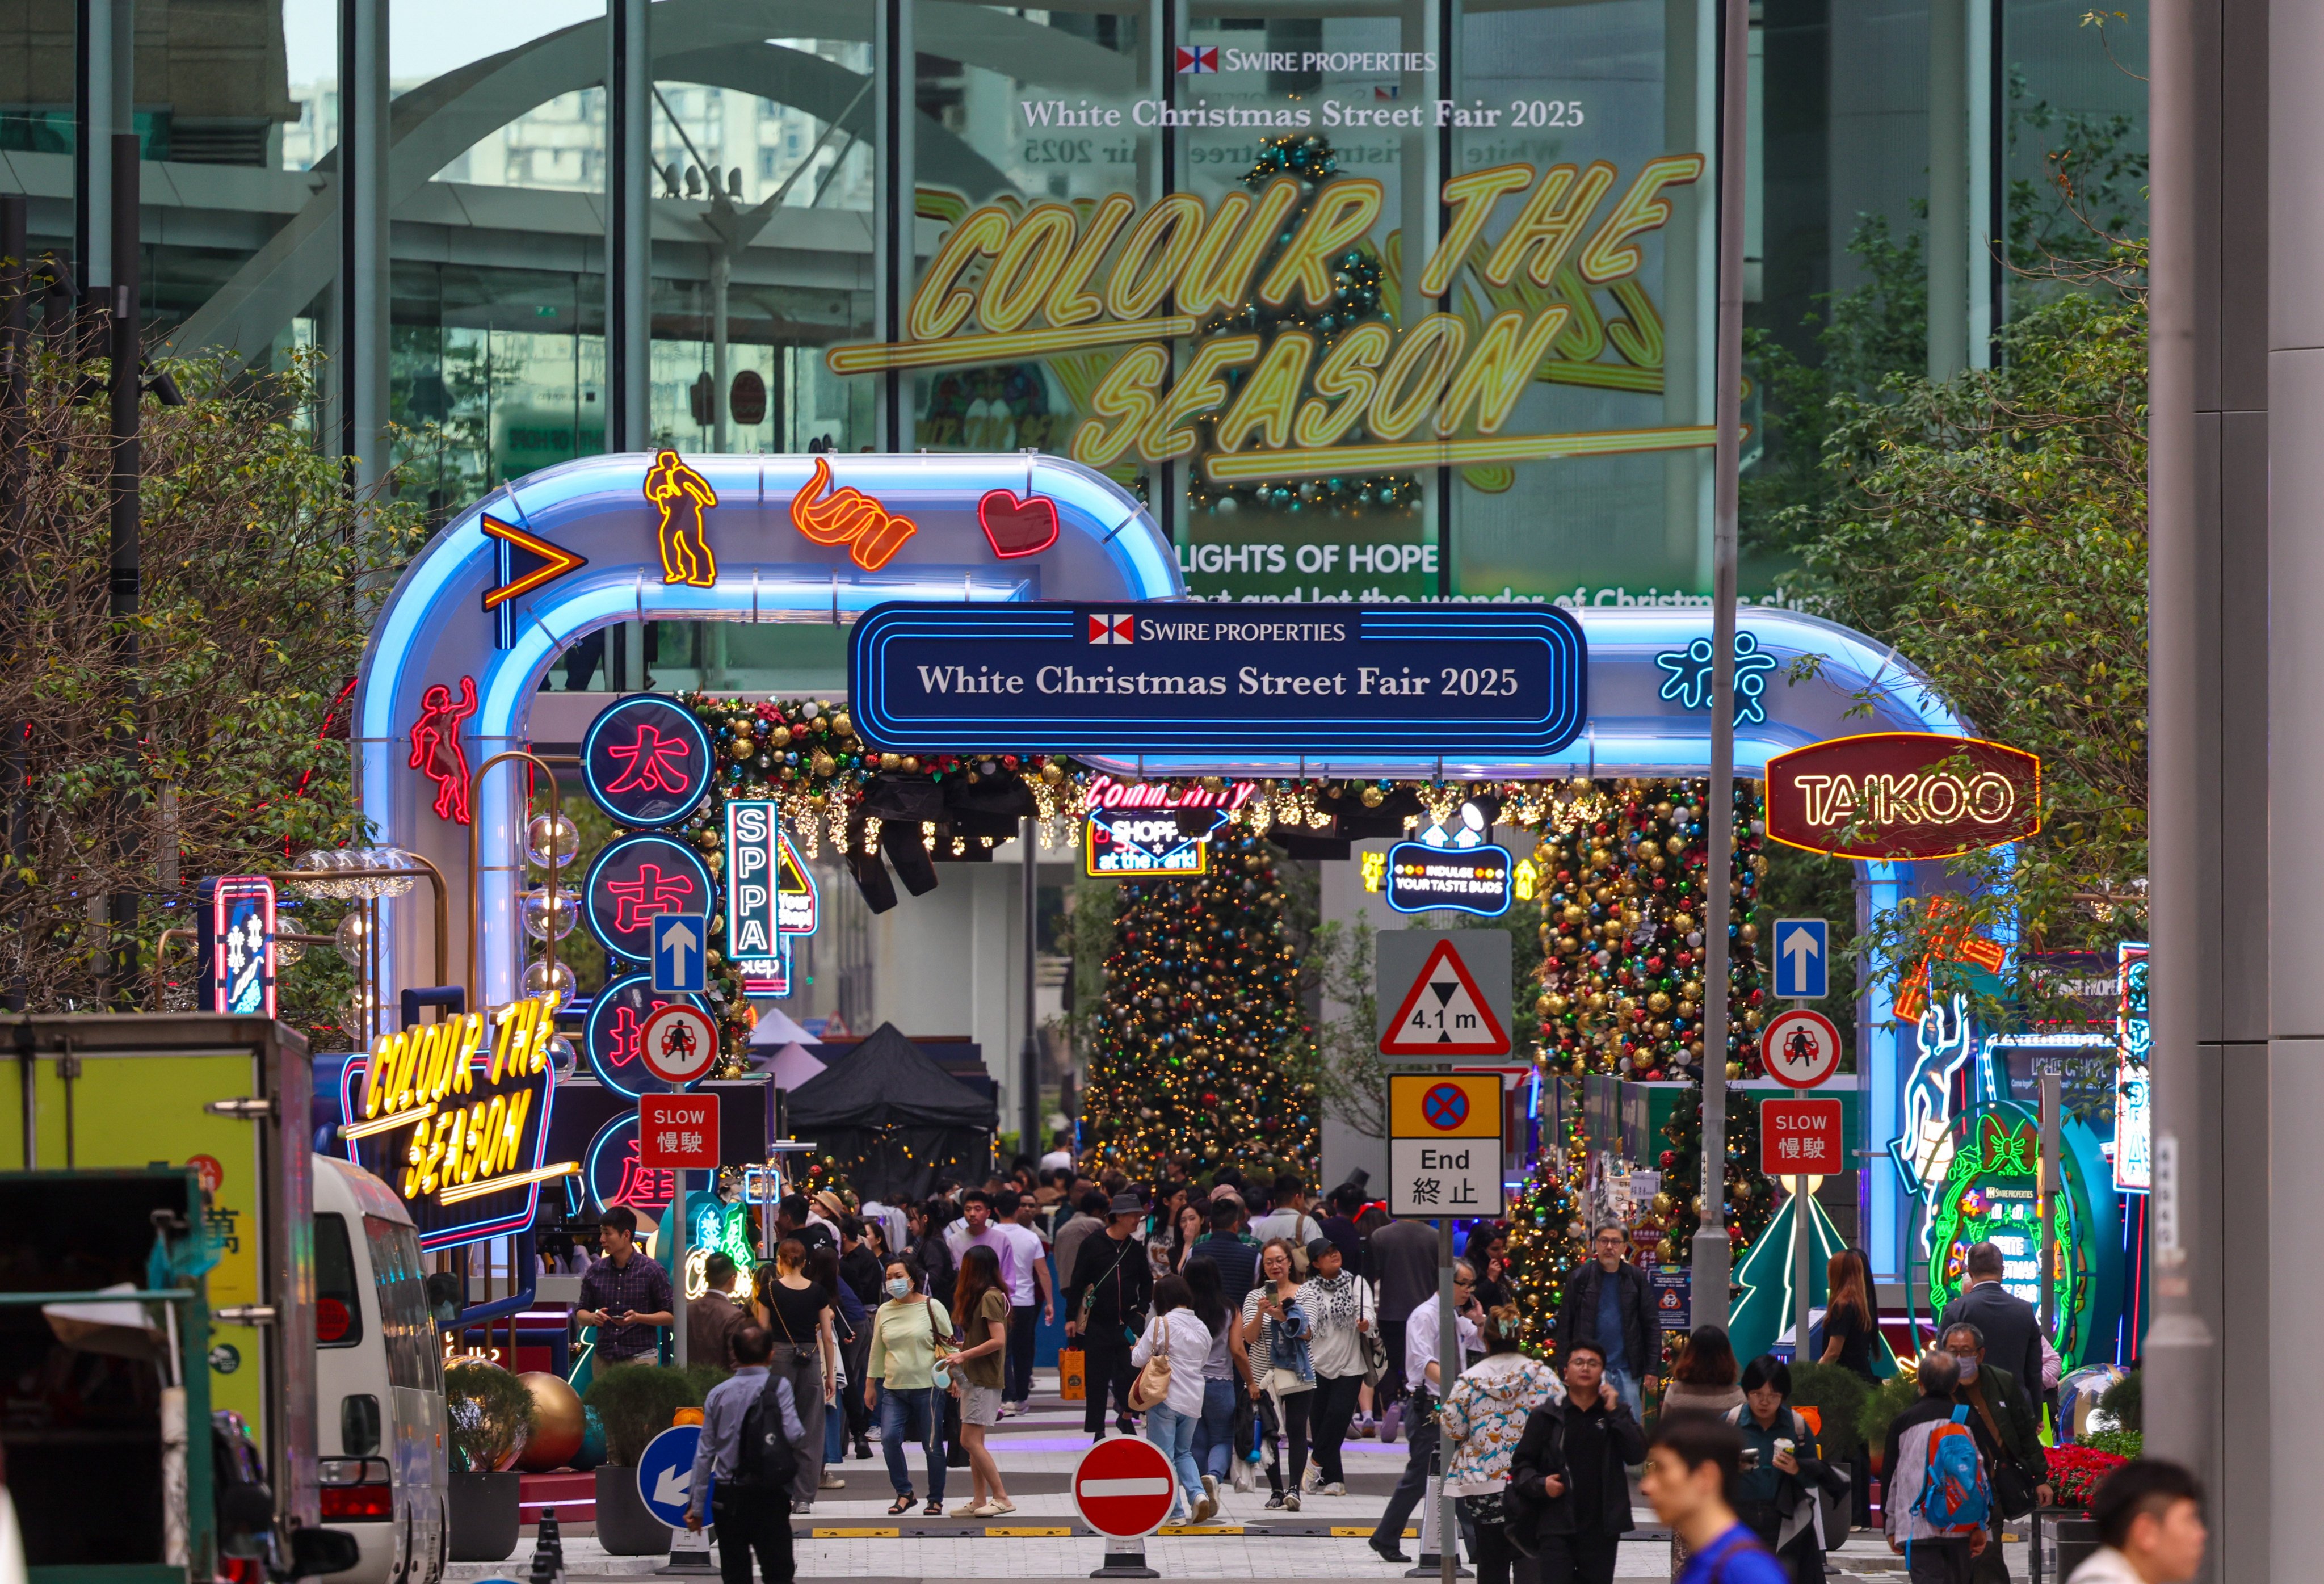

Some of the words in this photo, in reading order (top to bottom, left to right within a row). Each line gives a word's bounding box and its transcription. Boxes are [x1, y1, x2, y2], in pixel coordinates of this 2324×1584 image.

[1225, 48, 1297, 72] SWIRE
[1302, 52, 1437, 72] PROPERTIES
[1021, 99, 1121, 128] White
[1132, 99, 1312, 128] Christmas
[1323, 99, 1423, 128] Street
[1434, 99, 1502, 128] Fair
[1510, 100, 1585, 128] 2025
[909, 177, 1384, 341] COLOUR
[1419, 152, 1705, 299] THE
[1071, 304, 1572, 468] SEASON
[1177, 544, 1286, 573] LIGHTS
[1296, 544, 1339, 573] OF
[1348, 544, 1439, 573] HOPE
[1593, 587, 1750, 607] Christms
[1140, 618, 1211, 643] SWIRE
[1214, 621, 1346, 642] PROPERTIES
[917, 665, 1023, 697] White
[1036, 665, 1226, 697] Christmas
[1237, 665, 1347, 697] Street
[1356, 666, 1431, 696] Fair
[1440, 667, 1518, 696] 2025
[1794, 771, 2015, 826] TAIKOO
[1099, 851, 1119, 870] at
[1120, 851, 1151, 869] the
[1426, 865, 1475, 879] INDULGE
[736, 808, 768, 951] SPPA
[1396, 877, 1430, 891] YOUR
[1431, 879, 1468, 893] TASTE
[1469, 880, 1503, 894] BUDS
[1411, 1009, 1445, 1029] 4.1
[1455, 1012, 1477, 1028] m
[362, 1012, 484, 1120] COLOUR
[490, 990, 561, 1085] THE
[654, 1109, 705, 1124] SLOW
[1775, 1115, 1827, 1131] SLOW
[402, 1088, 533, 1199] SEASON
[657, 1131, 703, 1153] 慢駛
[1778, 1137, 1826, 1159] 慢駛
[1421, 1149, 1470, 1170] End
[1412, 1177, 1478, 1205] 終止
[2008, 1190, 2033, 1199] PROPERTIES
